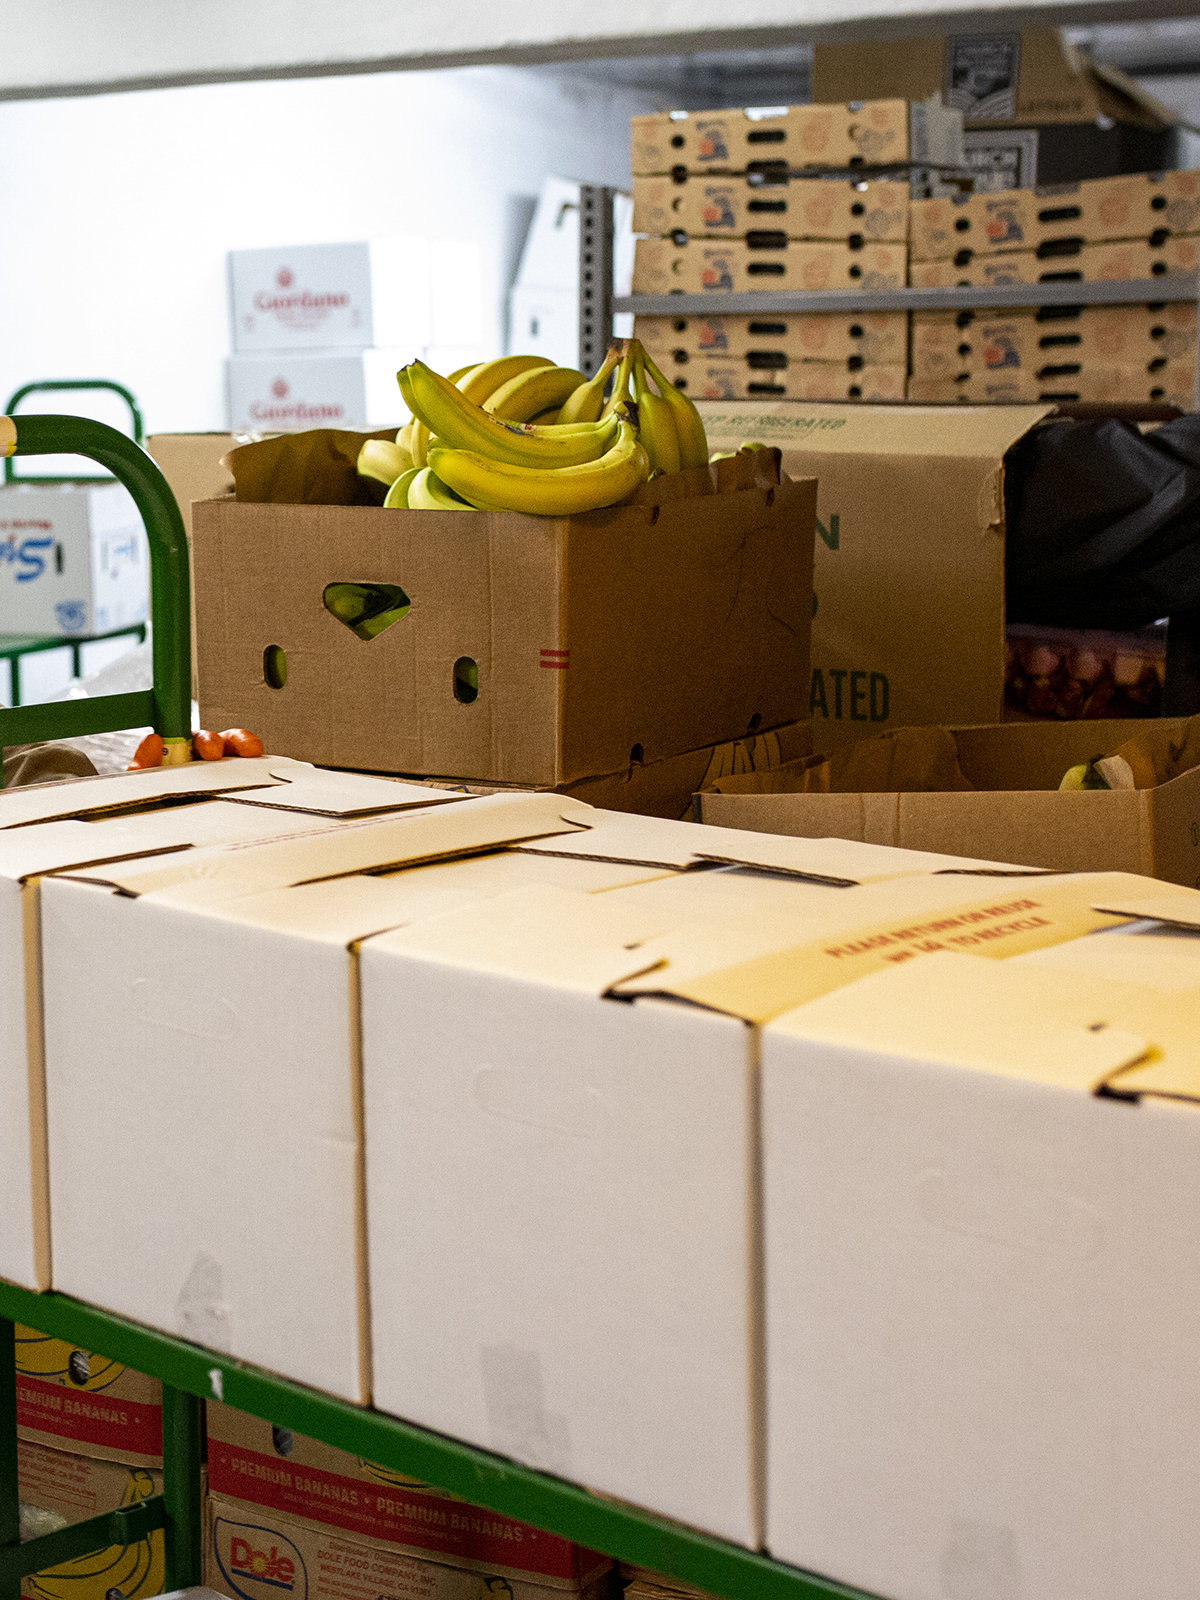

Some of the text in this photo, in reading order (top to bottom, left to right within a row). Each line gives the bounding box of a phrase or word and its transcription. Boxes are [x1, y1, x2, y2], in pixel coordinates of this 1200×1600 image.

[17, 1387, 62, 1411] EMIUM
[64, 1399, 128, 1427] BANANAS
[231, 1457, 292, 1487] PREMIUM
[295, 1475, 359, 1506] BANANAS
[376, 1496, 447, 1526] PREMIUM
[451, 1513, 523, 1543] BANANAS
[231, 1536, 295, 1582] Dole
[317, 1549, 342, 1564] DOLE
[343, 1555, 370, 1570] FOOD
[371, 1562, 419, 1584] COMPANY,
[319, 1563, 361, 1581] WESTLAKE
